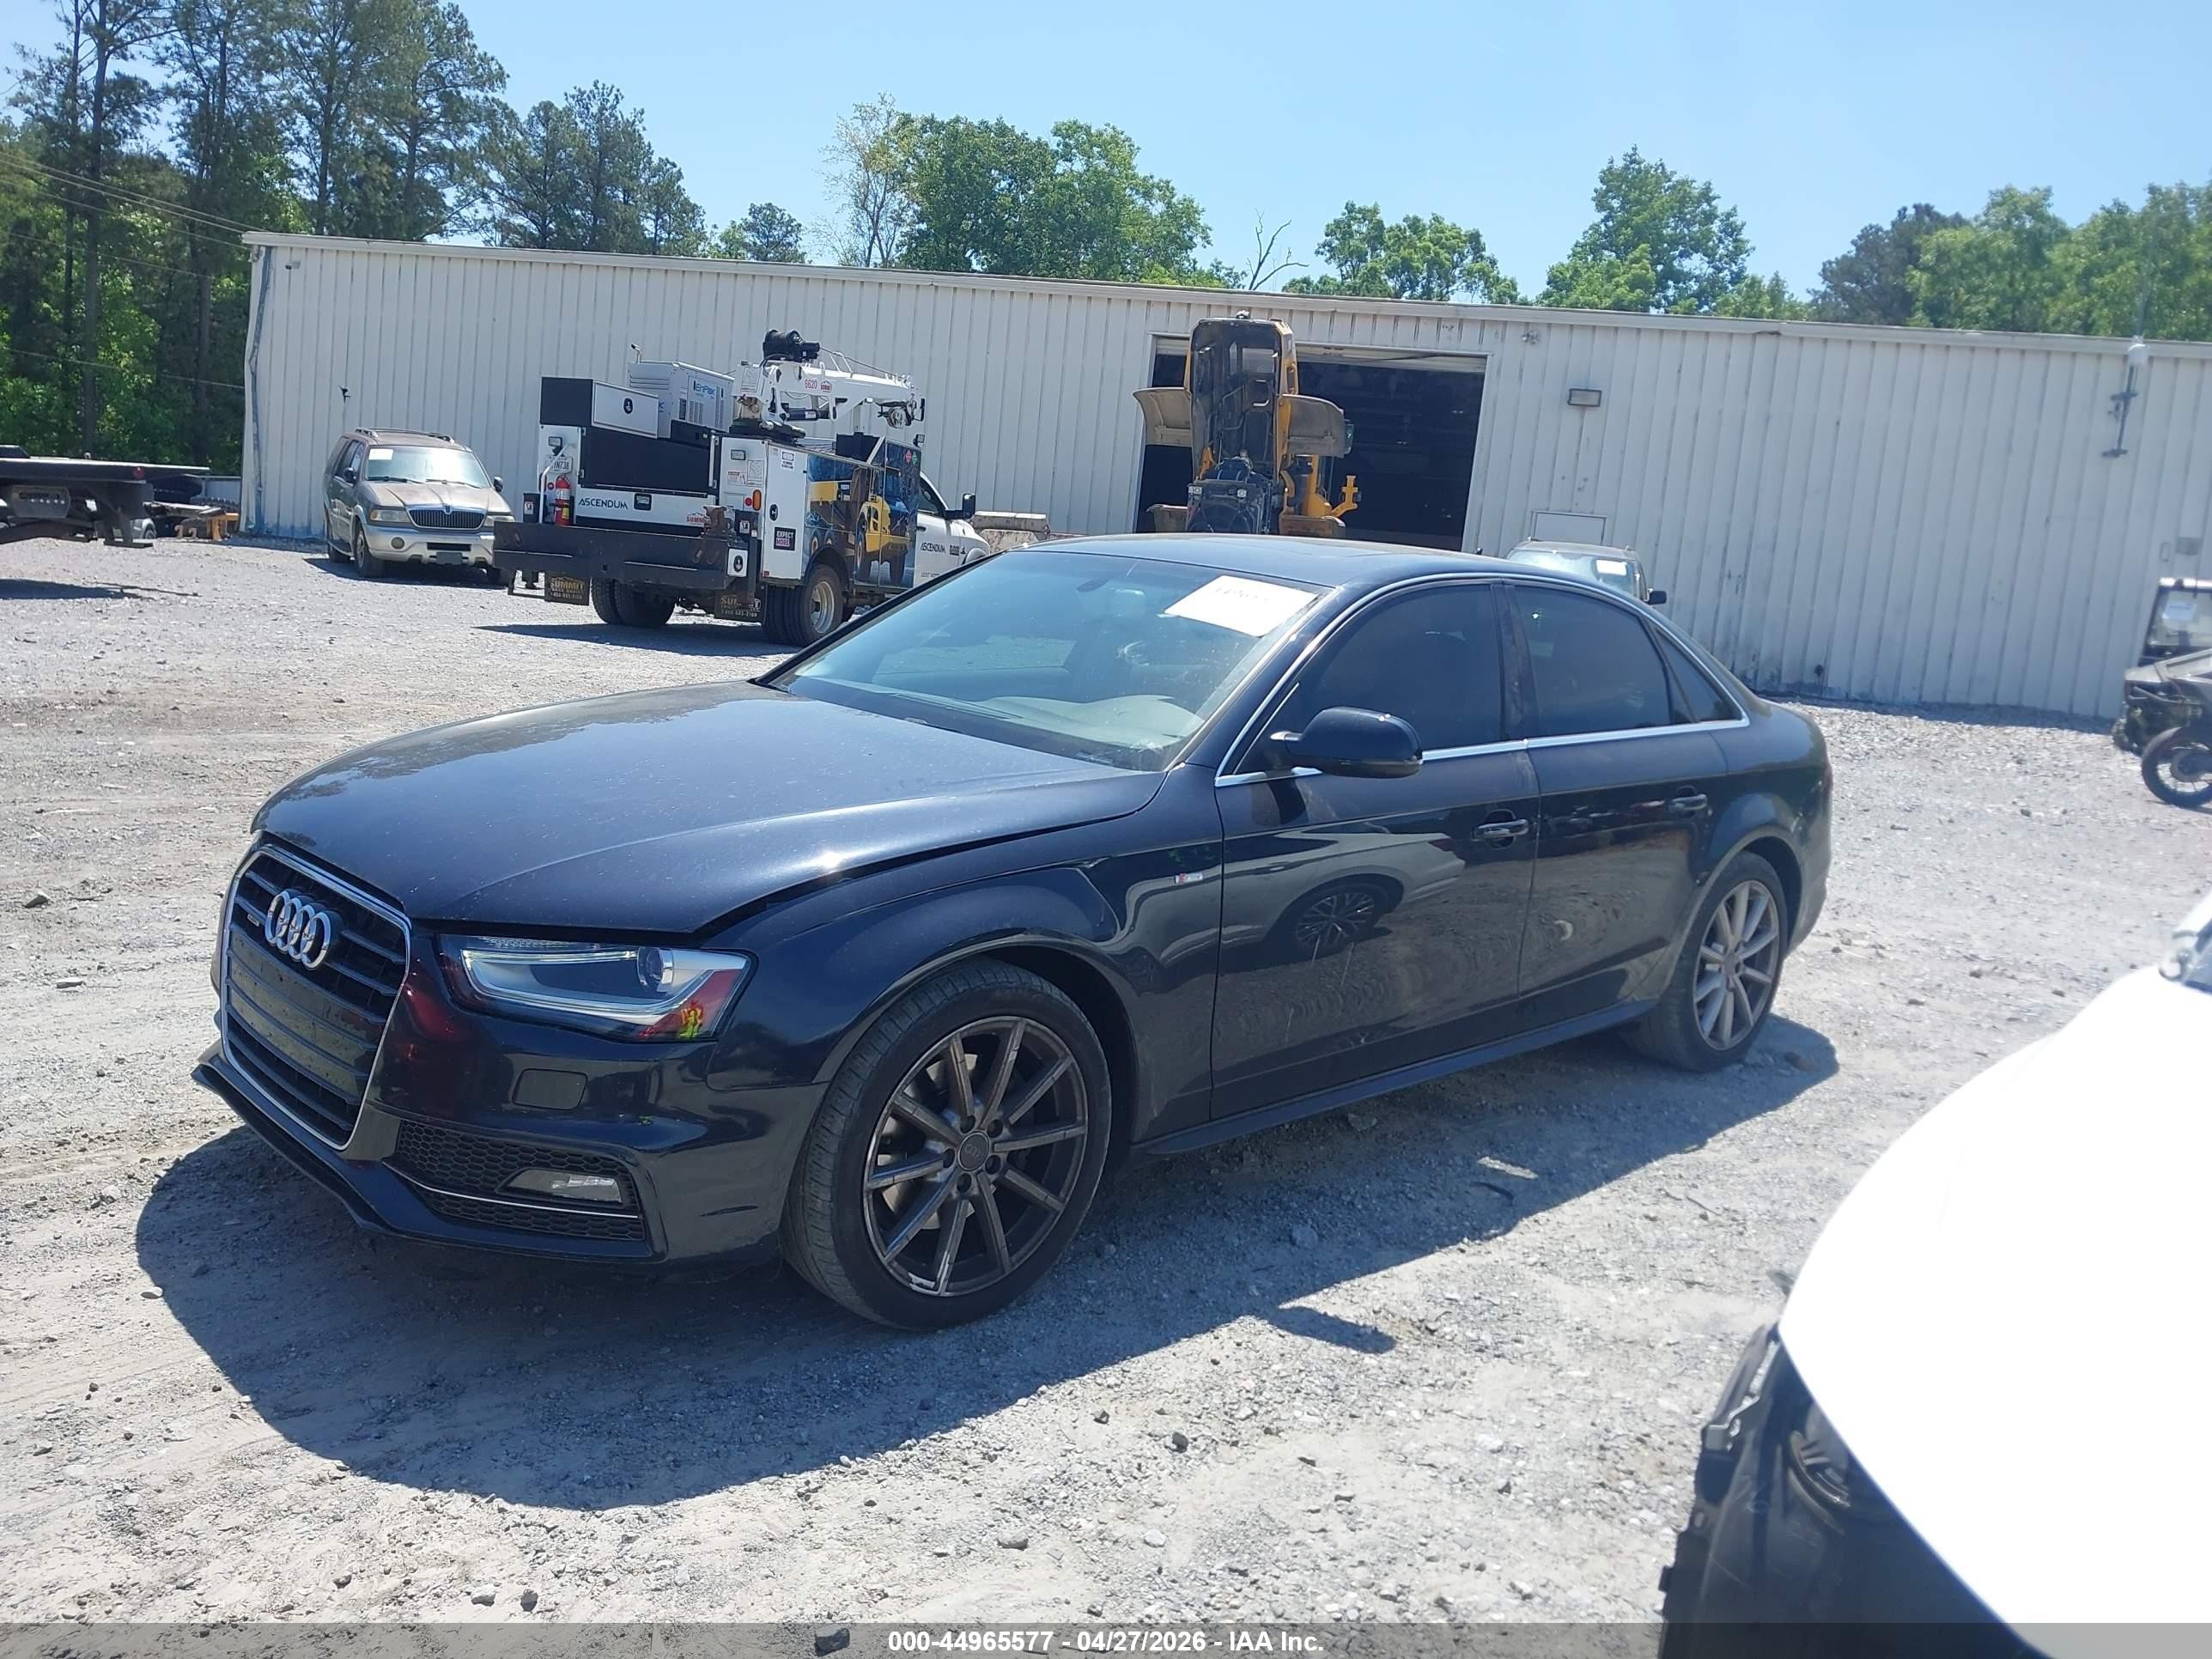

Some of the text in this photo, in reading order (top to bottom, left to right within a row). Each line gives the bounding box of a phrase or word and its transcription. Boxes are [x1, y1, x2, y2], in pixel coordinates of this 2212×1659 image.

[578, 497, 629, 510] ASCENDUM
[776, 530, 793, 538] EXPECT
[920, 542, 946, 554] ASCENDUM
[550, 577, 584, 590] SUMMIT
